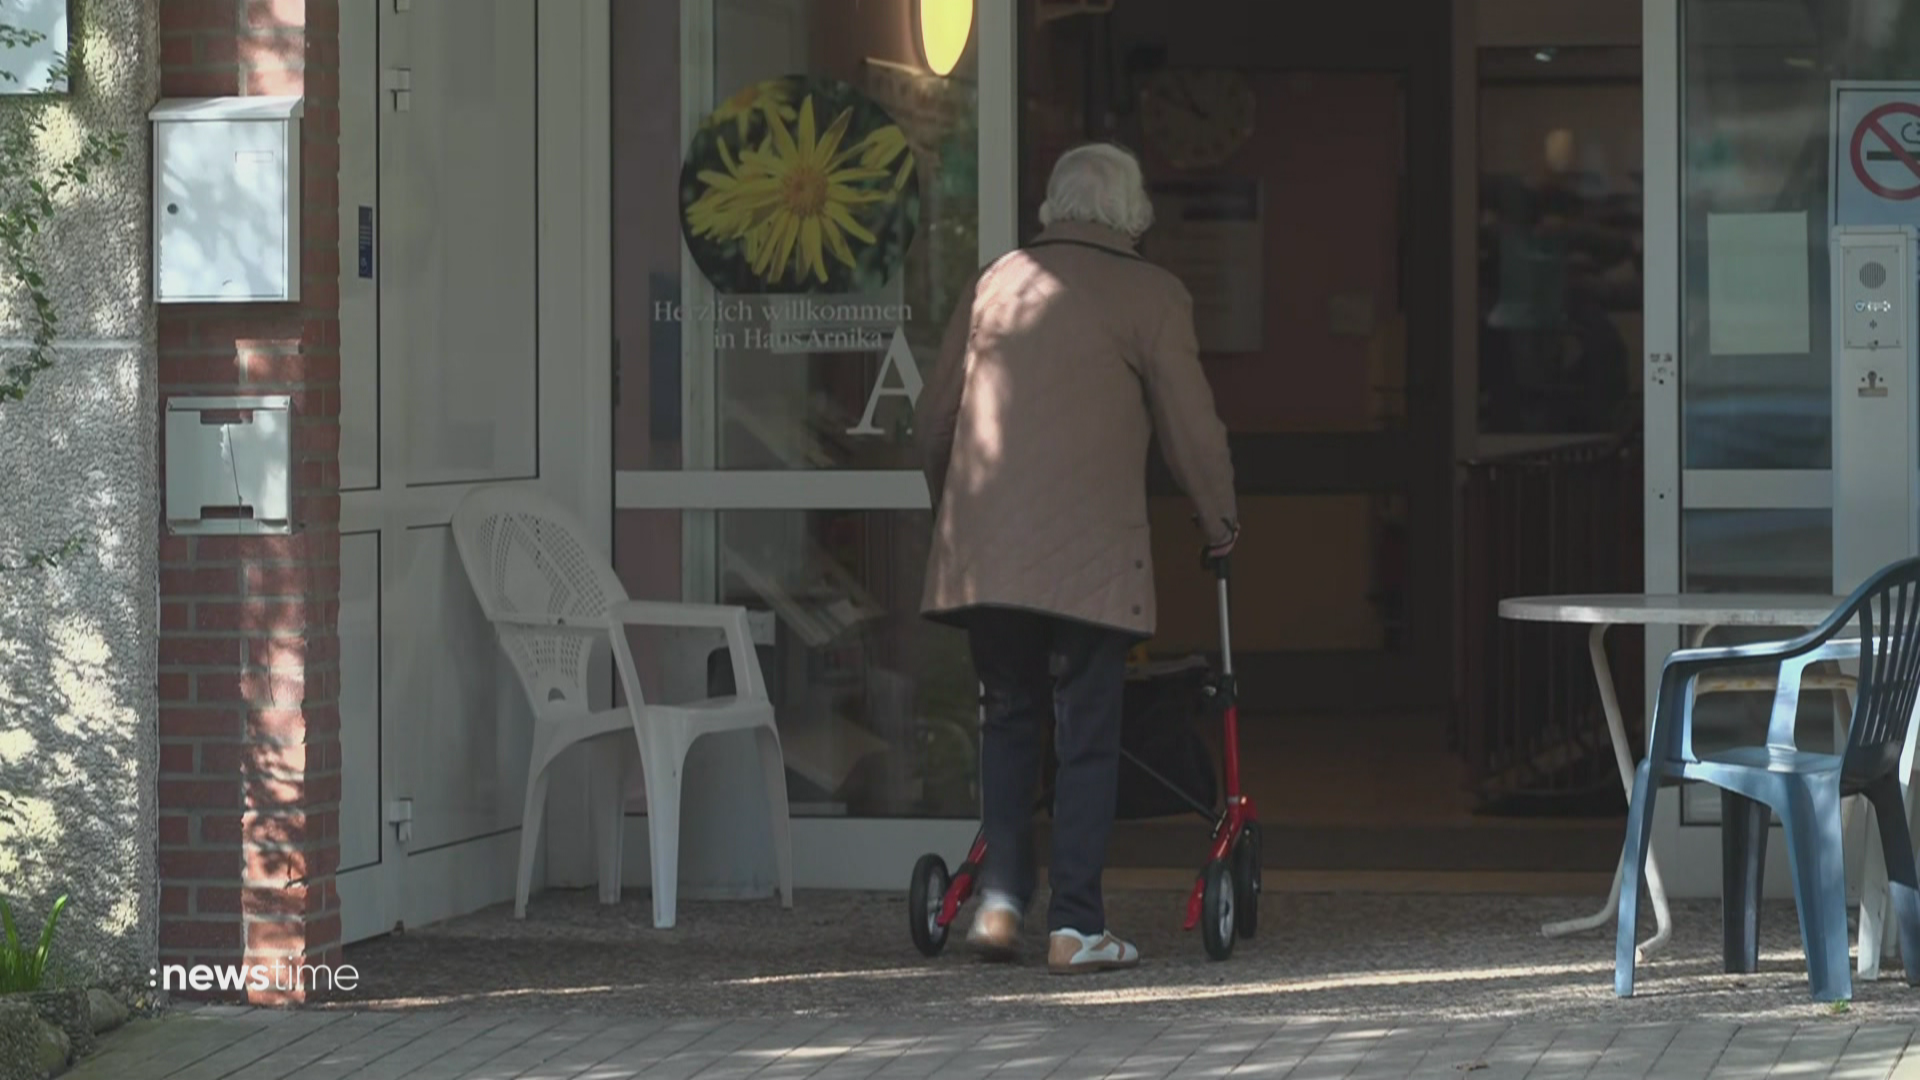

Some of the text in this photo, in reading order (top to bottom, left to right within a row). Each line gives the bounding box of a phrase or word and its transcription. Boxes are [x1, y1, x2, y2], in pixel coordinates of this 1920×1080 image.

[654, 299, 912, 322] Herzlich willkommen
[744, 328, 801, 349] Haus
[808, 327, 882, 349] Arnika
